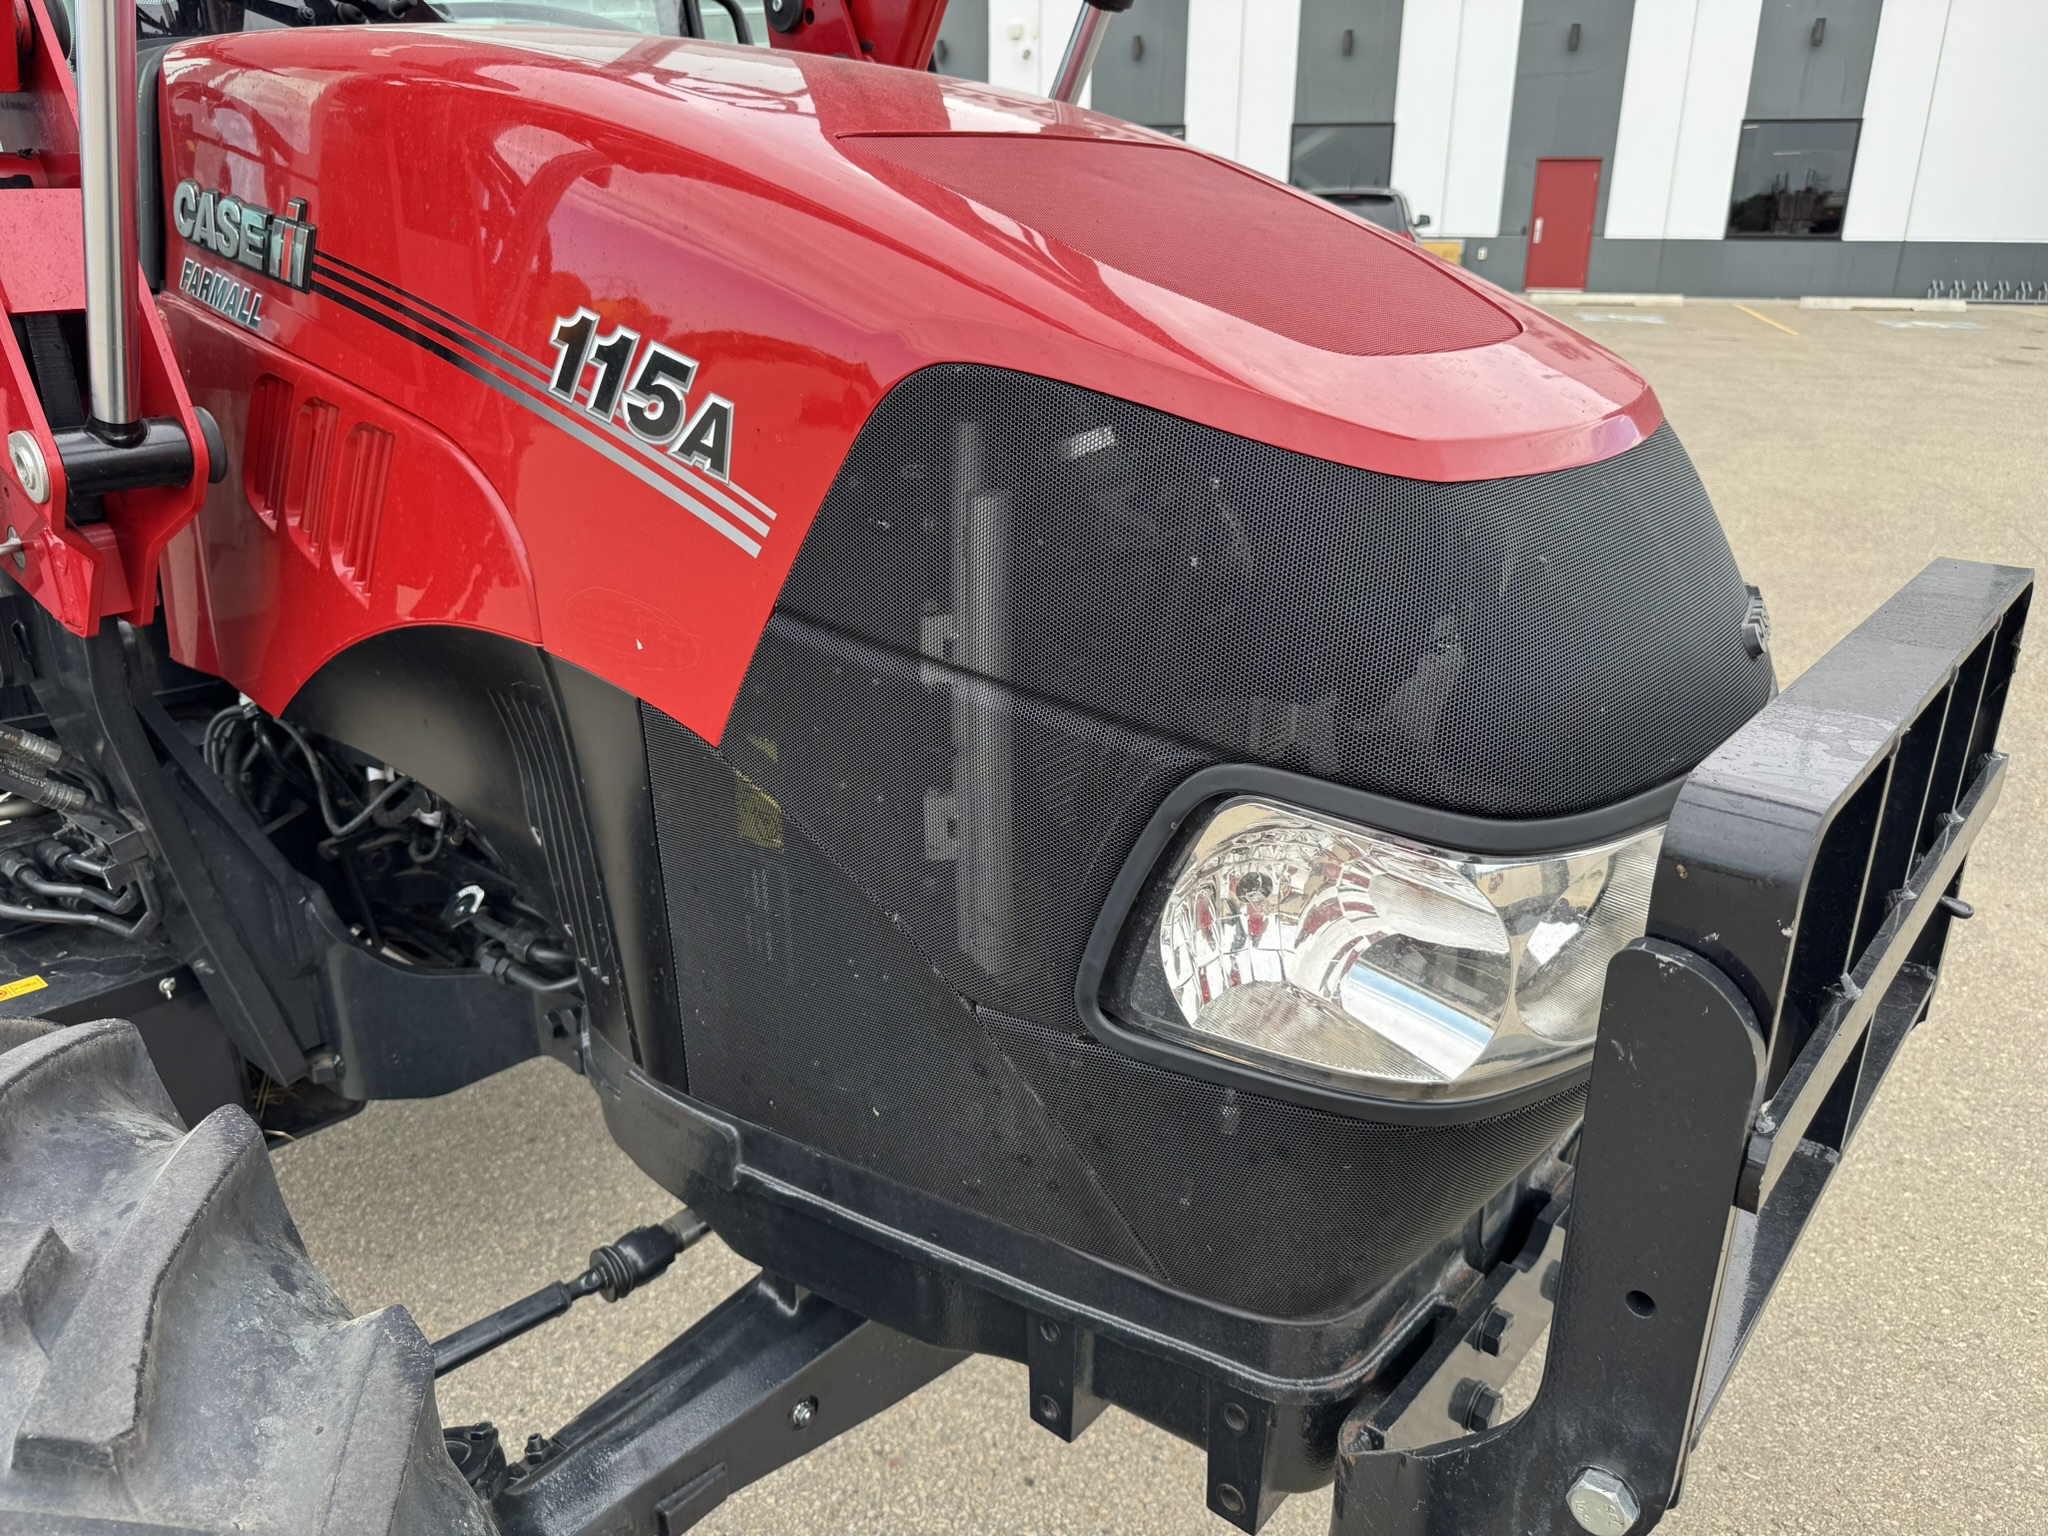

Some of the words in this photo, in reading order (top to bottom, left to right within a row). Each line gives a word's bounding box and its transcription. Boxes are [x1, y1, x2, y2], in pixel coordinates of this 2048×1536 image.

[174, 179, 275, 271] CASE
[179, 257, 263, 331] FARMALL
[548, 305, 735, 485] 115A
